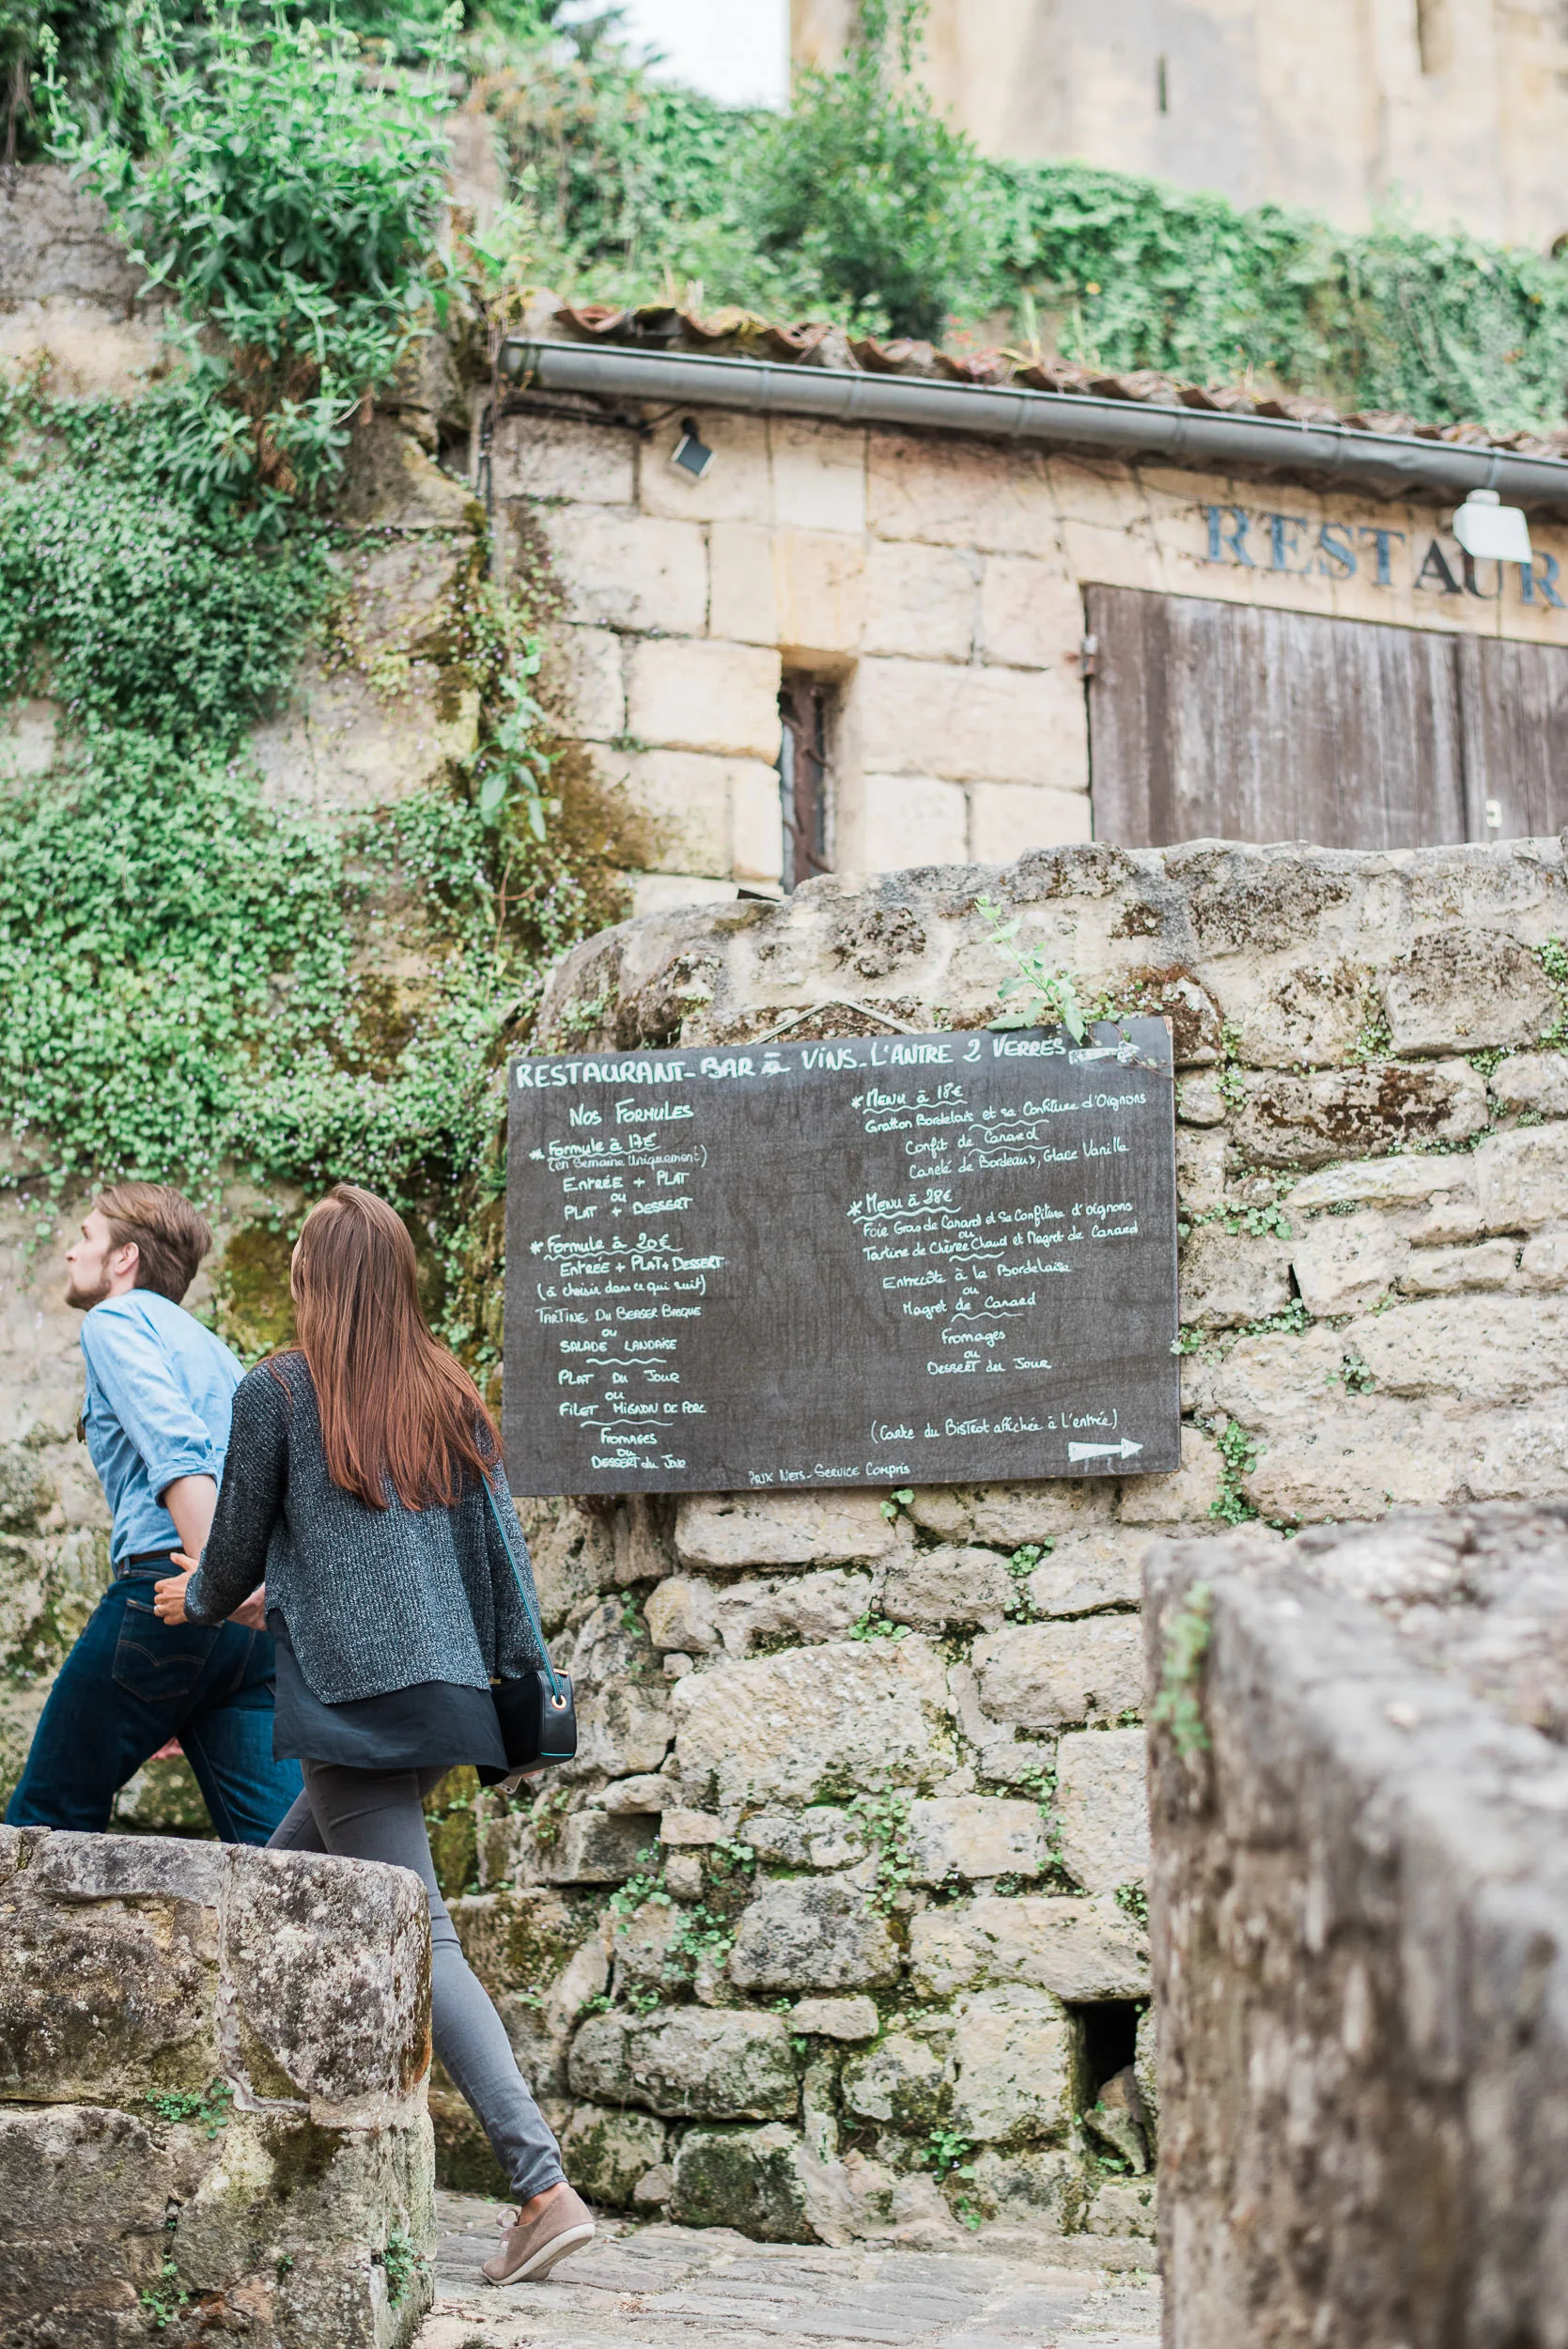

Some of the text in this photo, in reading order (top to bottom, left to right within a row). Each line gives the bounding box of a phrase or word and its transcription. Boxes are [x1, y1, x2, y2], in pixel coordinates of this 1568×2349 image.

[962, 1038, 982, 1063] 2
[938, 1082, 964, 1099] 18€
[982, 1106, 997, 1120] et
[905, 1137, 949, 1159] Confit
[957, 1134, 974, 1148] de
[957, 1156, 974, 1173] de
[657, 1170, 691, 1187] PLAT
[565, 1205, 598, 1221] PLAT
[632, 1196, 693, 1215] DESSERT
[862, 1221, 889, 1237] Foie
[923, 1217, 939, 1231] de
[912, 1242, 927, 1256] de
[1067, 1225, 1084, 1241] de
[971, 1264, 988, 1280] la
[955, 1299, 971, 1312] de
[559, 1340, 608, 1353] SALADE
[557, 1369, 595, 1385] PLAT
[924, 1422, 940, 1439] du
